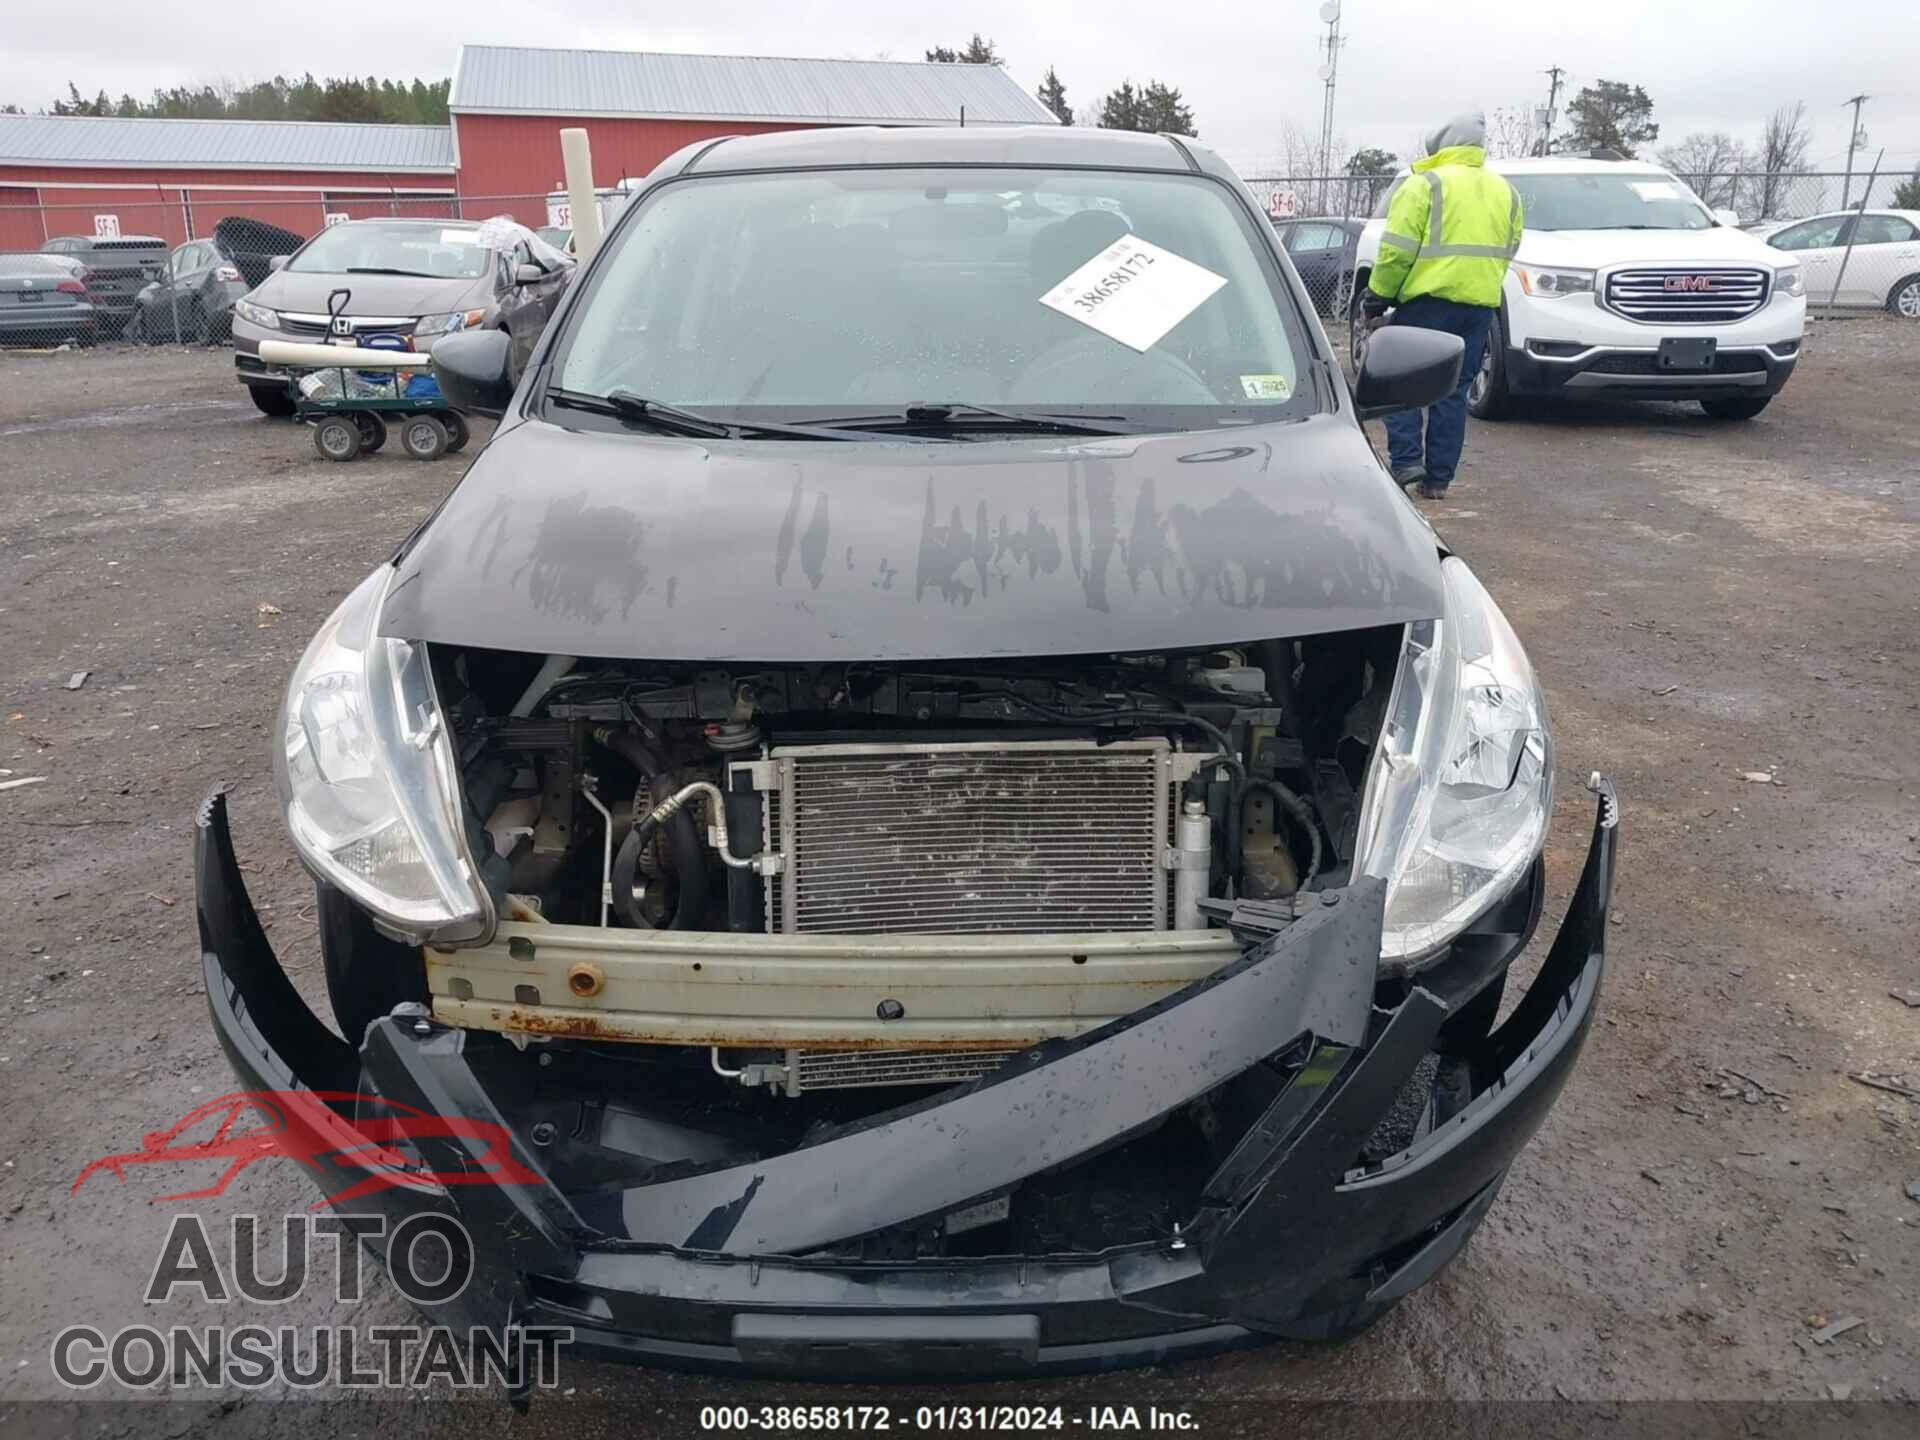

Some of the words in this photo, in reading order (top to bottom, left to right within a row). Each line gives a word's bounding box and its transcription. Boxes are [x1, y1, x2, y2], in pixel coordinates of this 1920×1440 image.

[1271, 192, 1294, 212] SF-6
[1074, 252, 1156, 313] 38658172
[1663, 275, 1724, 292] GMC
